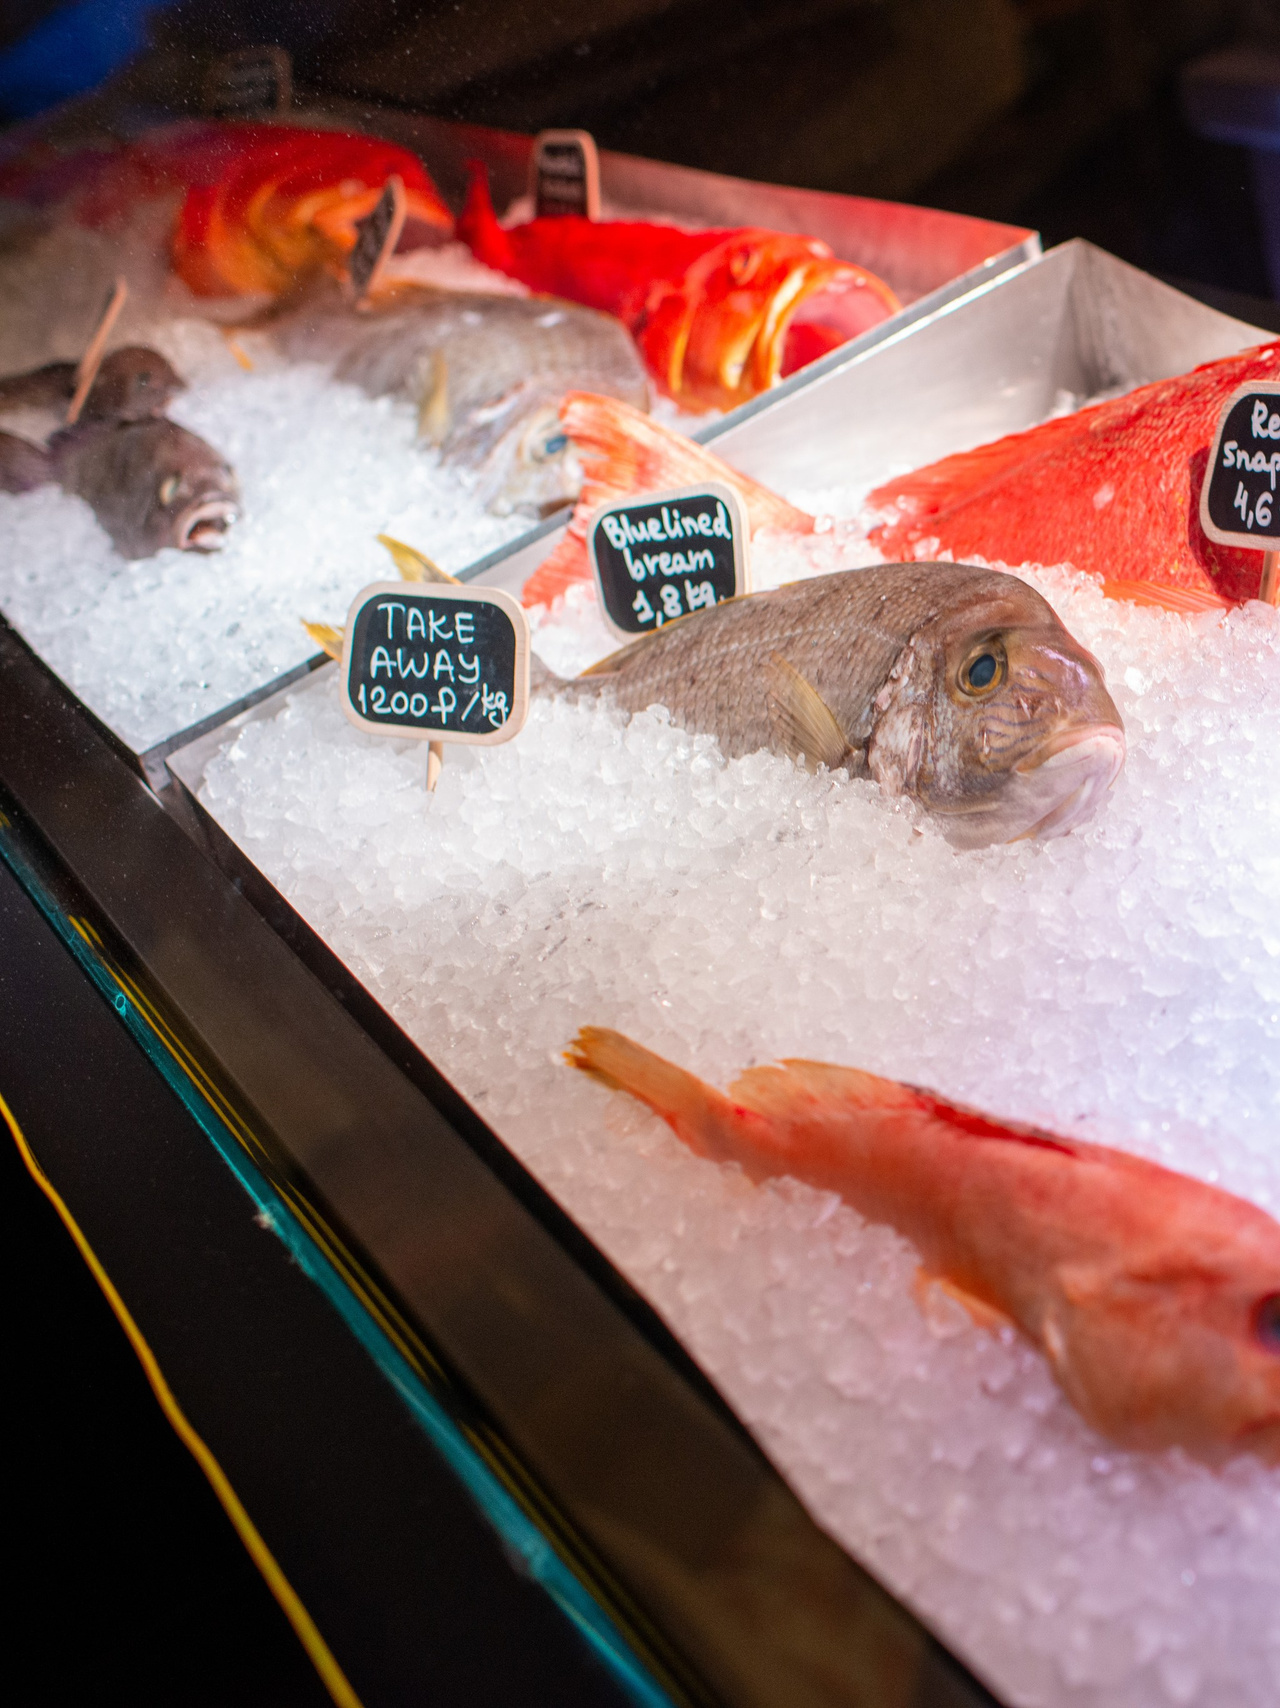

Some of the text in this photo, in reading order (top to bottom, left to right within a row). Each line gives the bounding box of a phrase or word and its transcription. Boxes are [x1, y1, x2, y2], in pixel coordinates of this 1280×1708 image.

[601, 501, 732, 550] Bluelined
[1234, 480, 1273, 530] 4,6
[623, 547, 715, 582] bream
[377, 602, 475, 644] TAKE
[370, 646, 481, 684] AWAY
